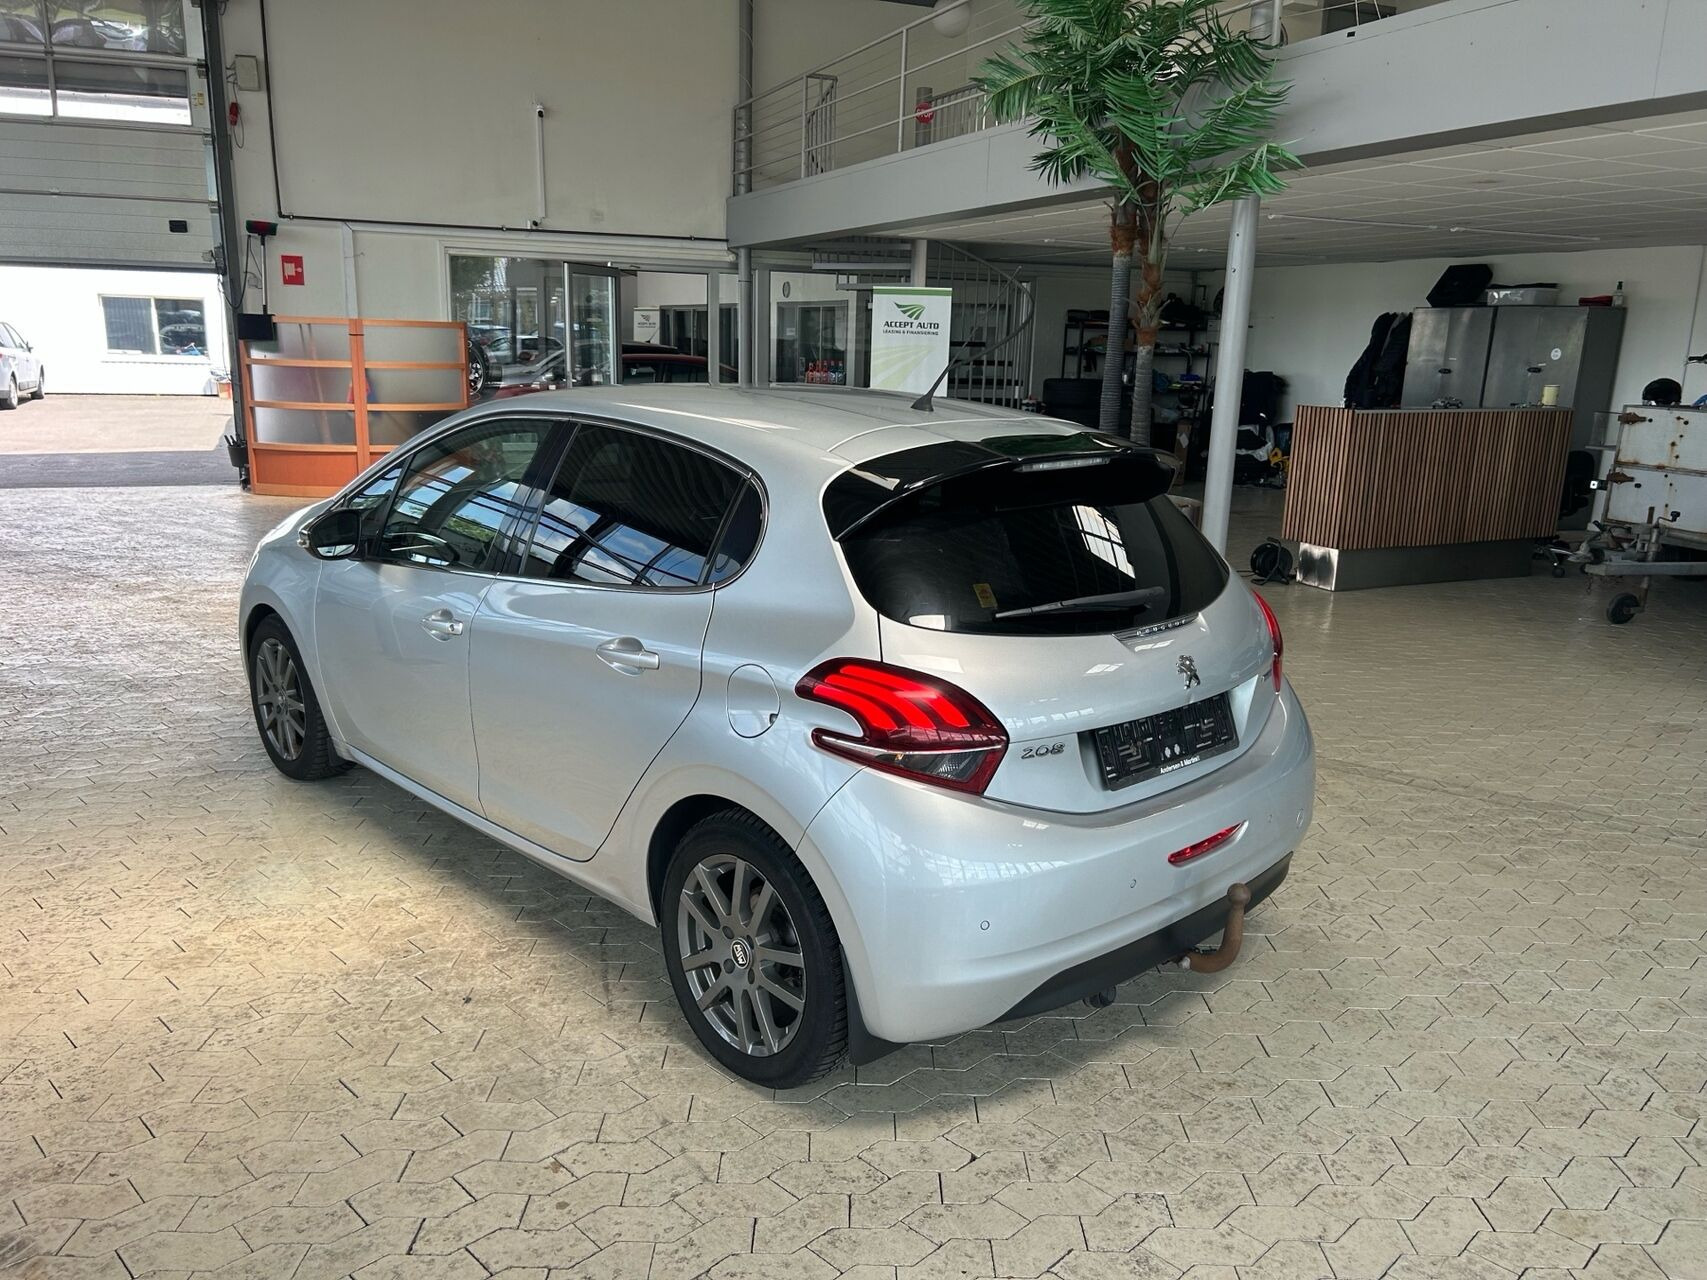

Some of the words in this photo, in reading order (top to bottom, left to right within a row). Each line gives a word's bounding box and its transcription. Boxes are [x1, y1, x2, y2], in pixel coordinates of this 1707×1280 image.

[883, 320, 914, 329] ACCEPT
[916, 322, 940, 330] AUTO
[1021, 742, 1065, 759] 208
